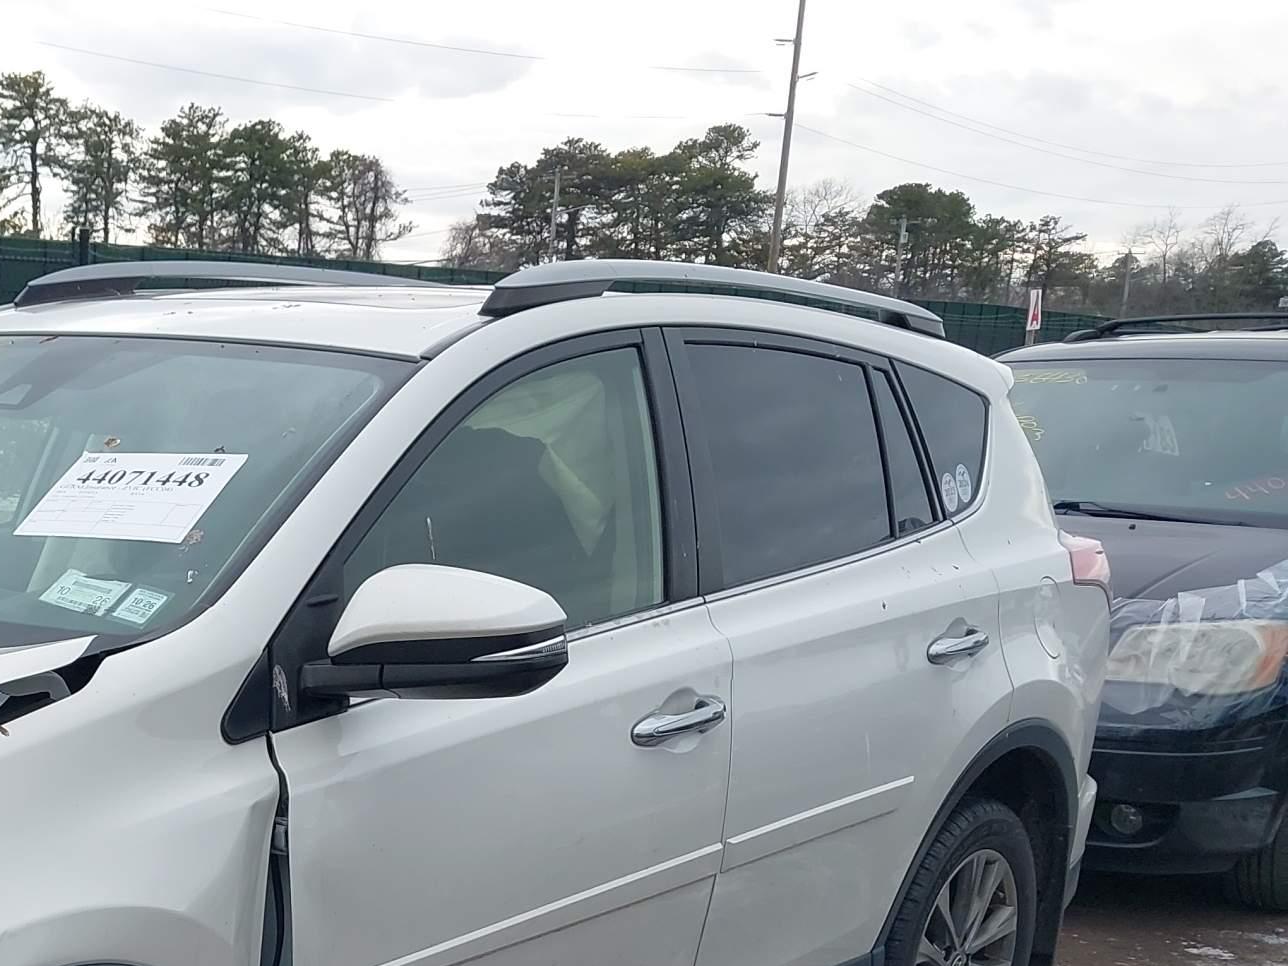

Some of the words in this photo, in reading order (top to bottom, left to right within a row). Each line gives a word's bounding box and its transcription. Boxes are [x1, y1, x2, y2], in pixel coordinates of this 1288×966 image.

[76, 469, 211, 488] 44071448
[56, 585, 71, 596] 10
[131, 596, 144, 606] 10
[143, 600, 157, 610] 26
